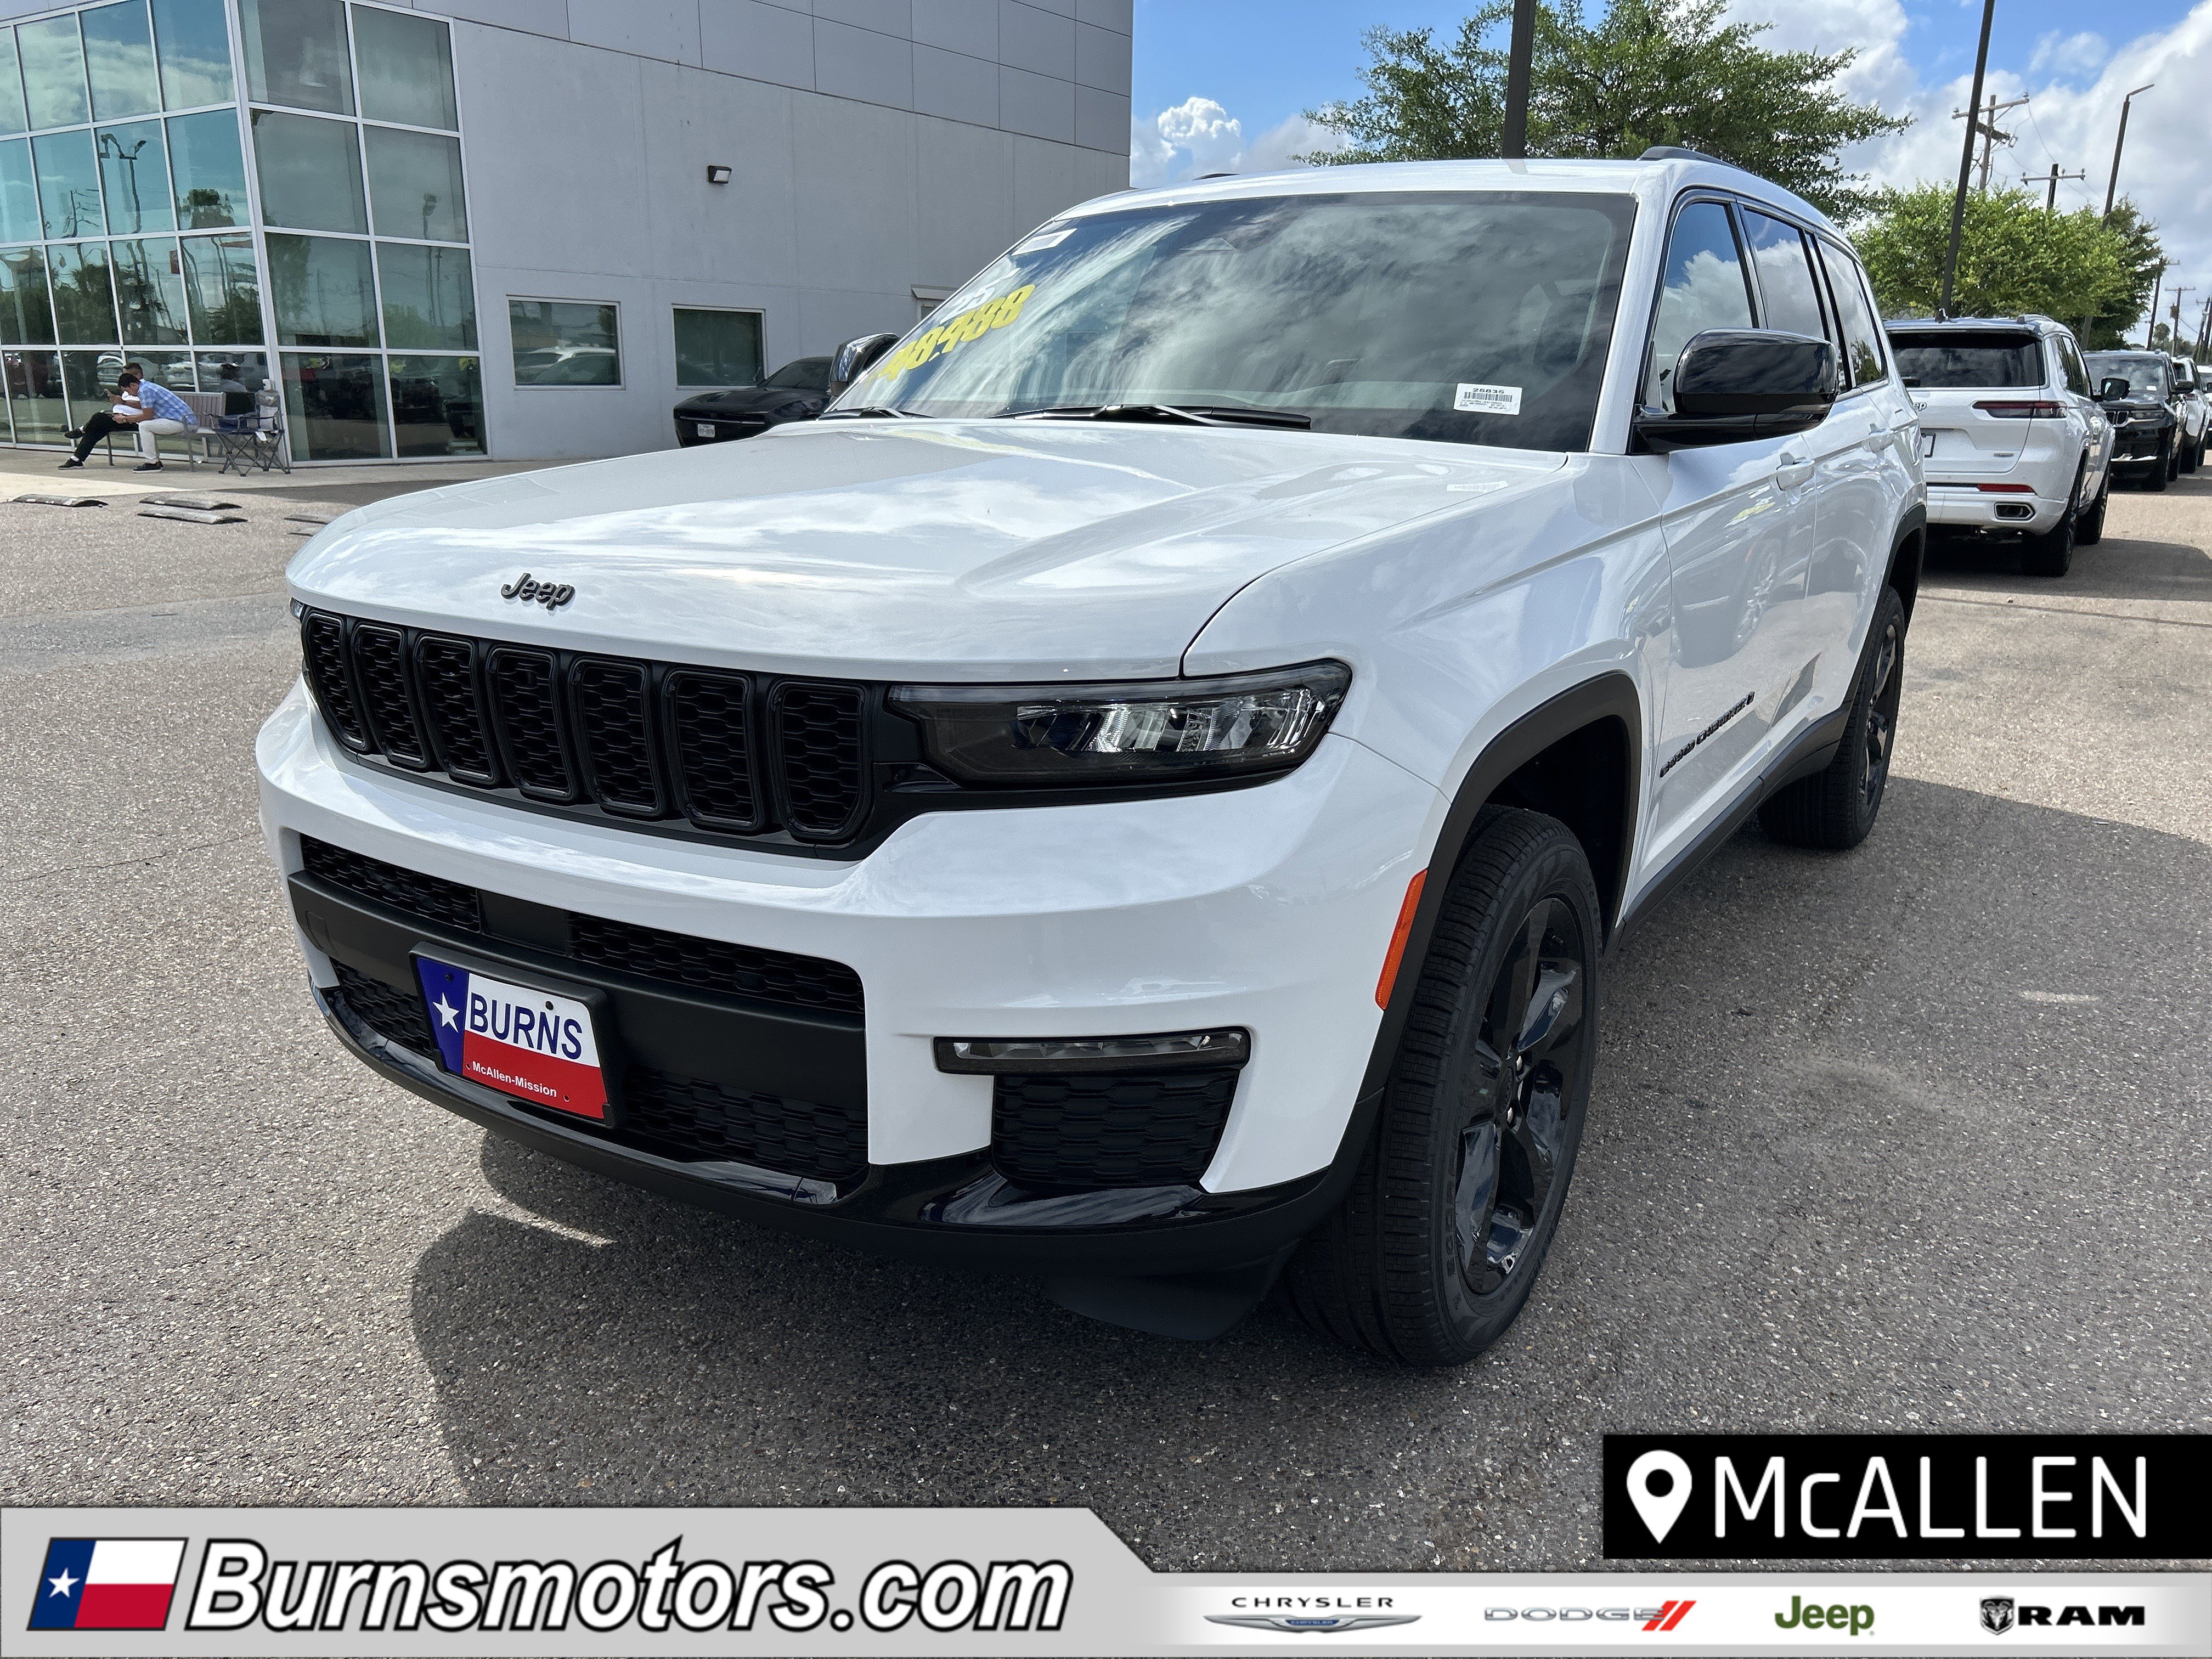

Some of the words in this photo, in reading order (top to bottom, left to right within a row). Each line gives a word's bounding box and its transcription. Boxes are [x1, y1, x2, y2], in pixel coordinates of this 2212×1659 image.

[1914, 402, 1927, 411] ep
[500, 572, 575, 611] Jeep
[470, 992, 583, 1060] BURNS
[472, 1060, 557, 1098] McAllen-Mission
